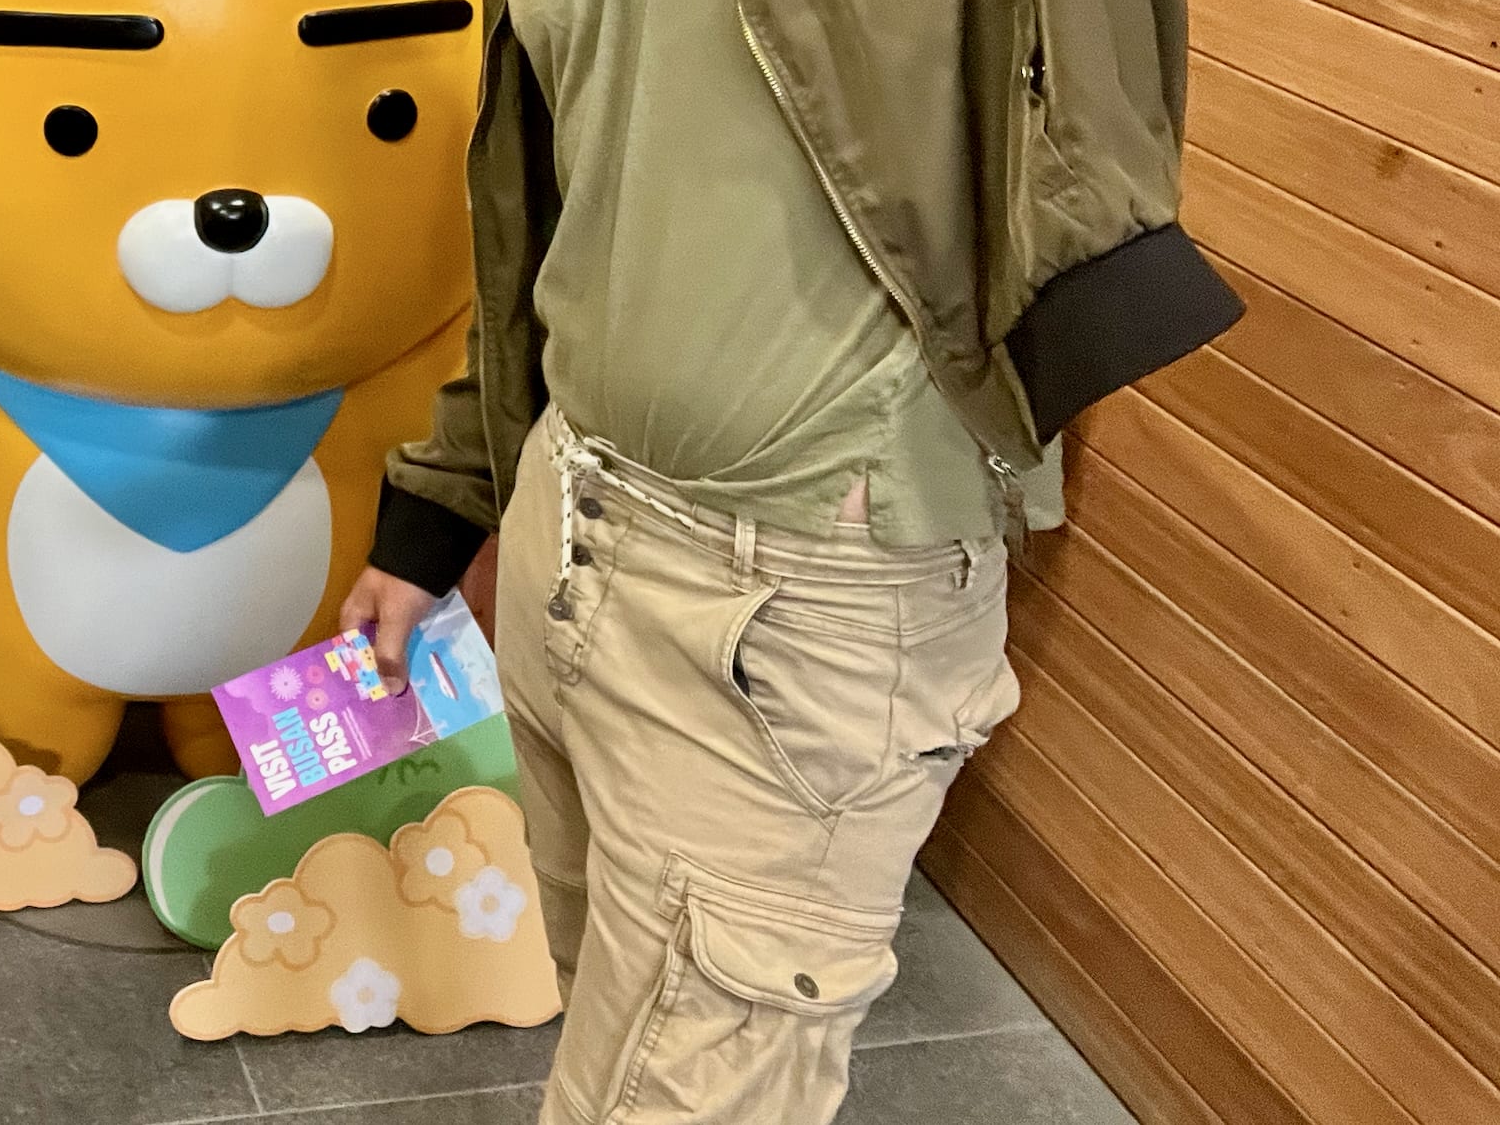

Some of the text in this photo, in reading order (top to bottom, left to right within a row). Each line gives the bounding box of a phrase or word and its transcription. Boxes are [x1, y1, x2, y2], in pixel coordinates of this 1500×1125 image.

[250, 739, 297, 801] VISIT
[272, 707, 328, 788] BUSAN
[309, 711, 358, 775] PASS
